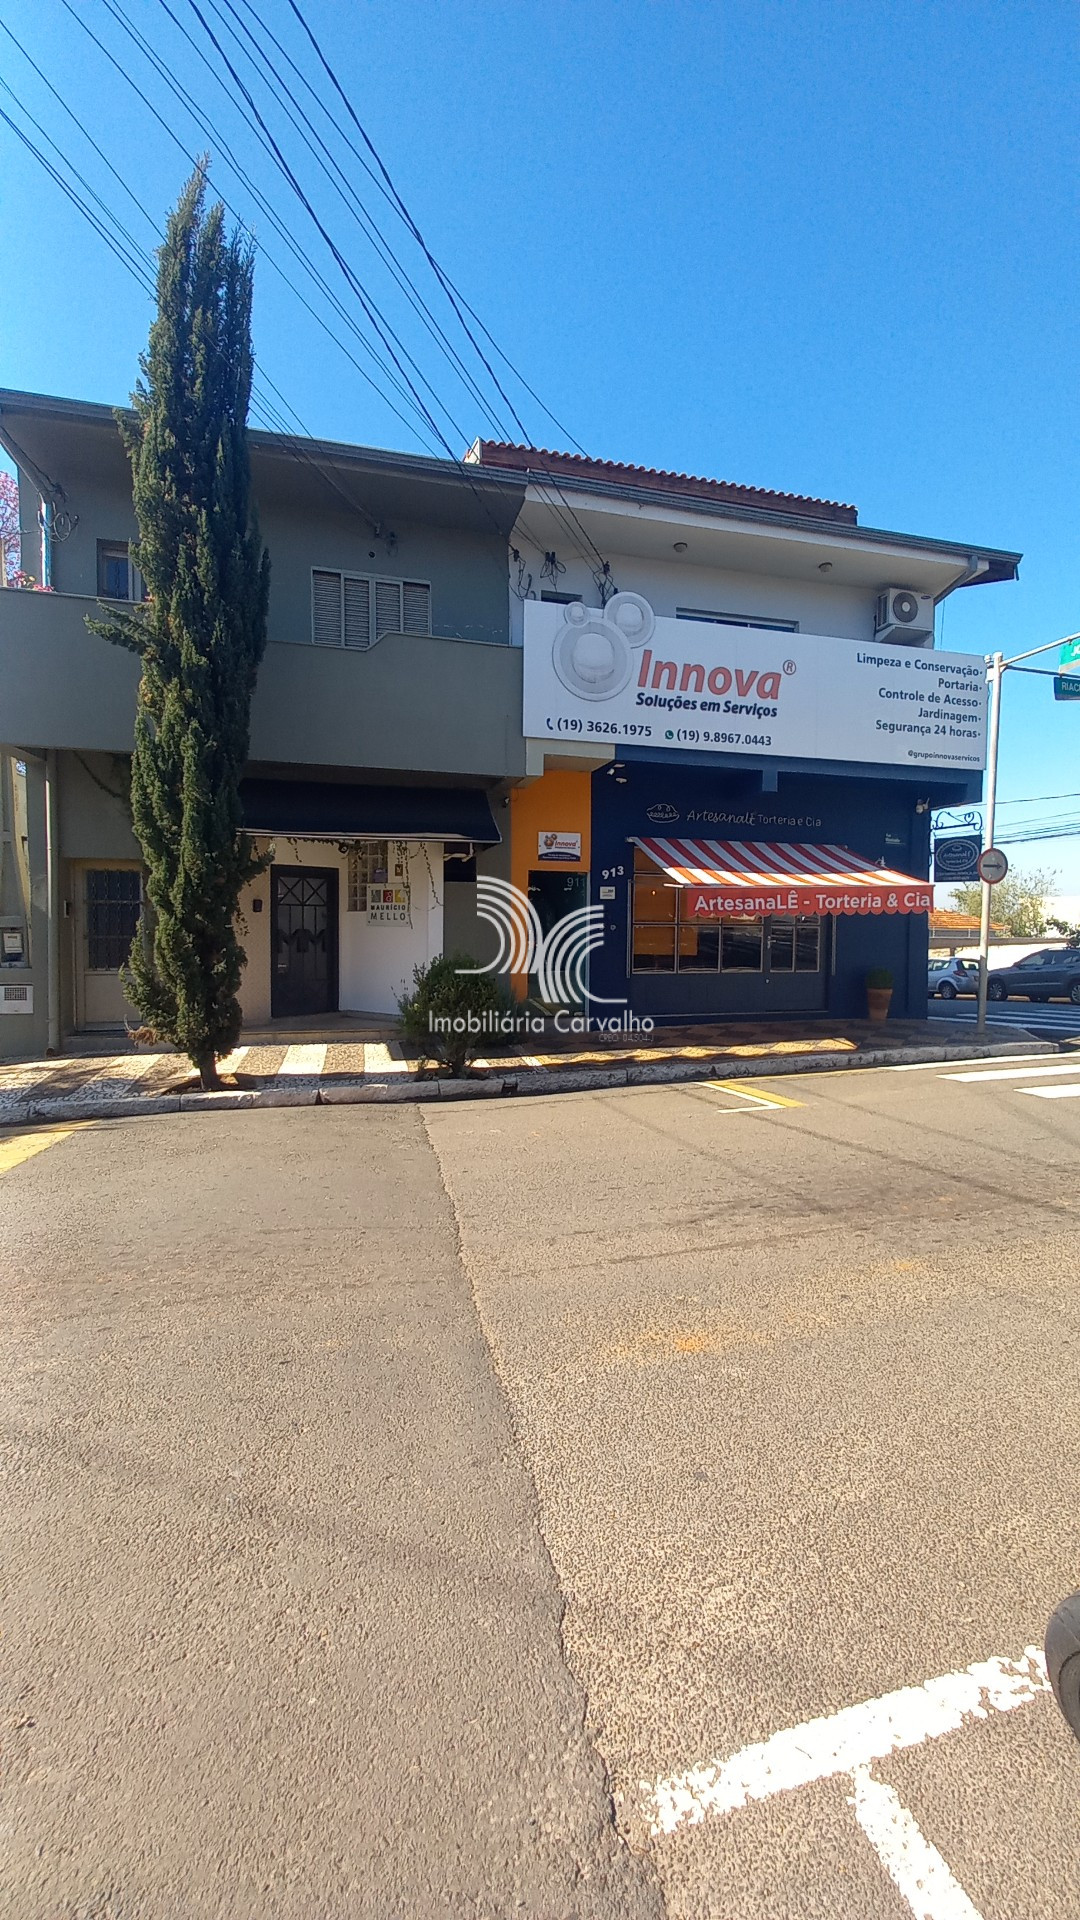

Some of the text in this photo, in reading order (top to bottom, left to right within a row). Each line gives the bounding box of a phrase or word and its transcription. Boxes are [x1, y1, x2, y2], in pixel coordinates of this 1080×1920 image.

[856, 653, 979, 676] Limpeza e Conservação
[637, 650, 782, 700] Innova
[938, 678, 979, 693] Portaria
[635, 692, 778, 720] Soluções em Serviços
[878, 687, 979, 708] Controle de Acesso
[918, 707, 979, 723] Jardinagem
[557, 717, 652, 738] (19) 3626.1975
[875, 719, 978, 739] Segurança 24 horas
[676, 728, 772, 747] (19) 9.8967.0443
[907, 749, 980, 763] @grupoinnovaservicos
[805, 816, 822, 828] Cia
[601, 865, 624, 880] 913
[695, 890, 799, 912] ArtesanaLÊ
[815, 893, 883, 910] Torteria
[886, 893, 899, 909] &
[903, 892, 931, 908] Cia
[370, 912, 406, 921] MELLO
